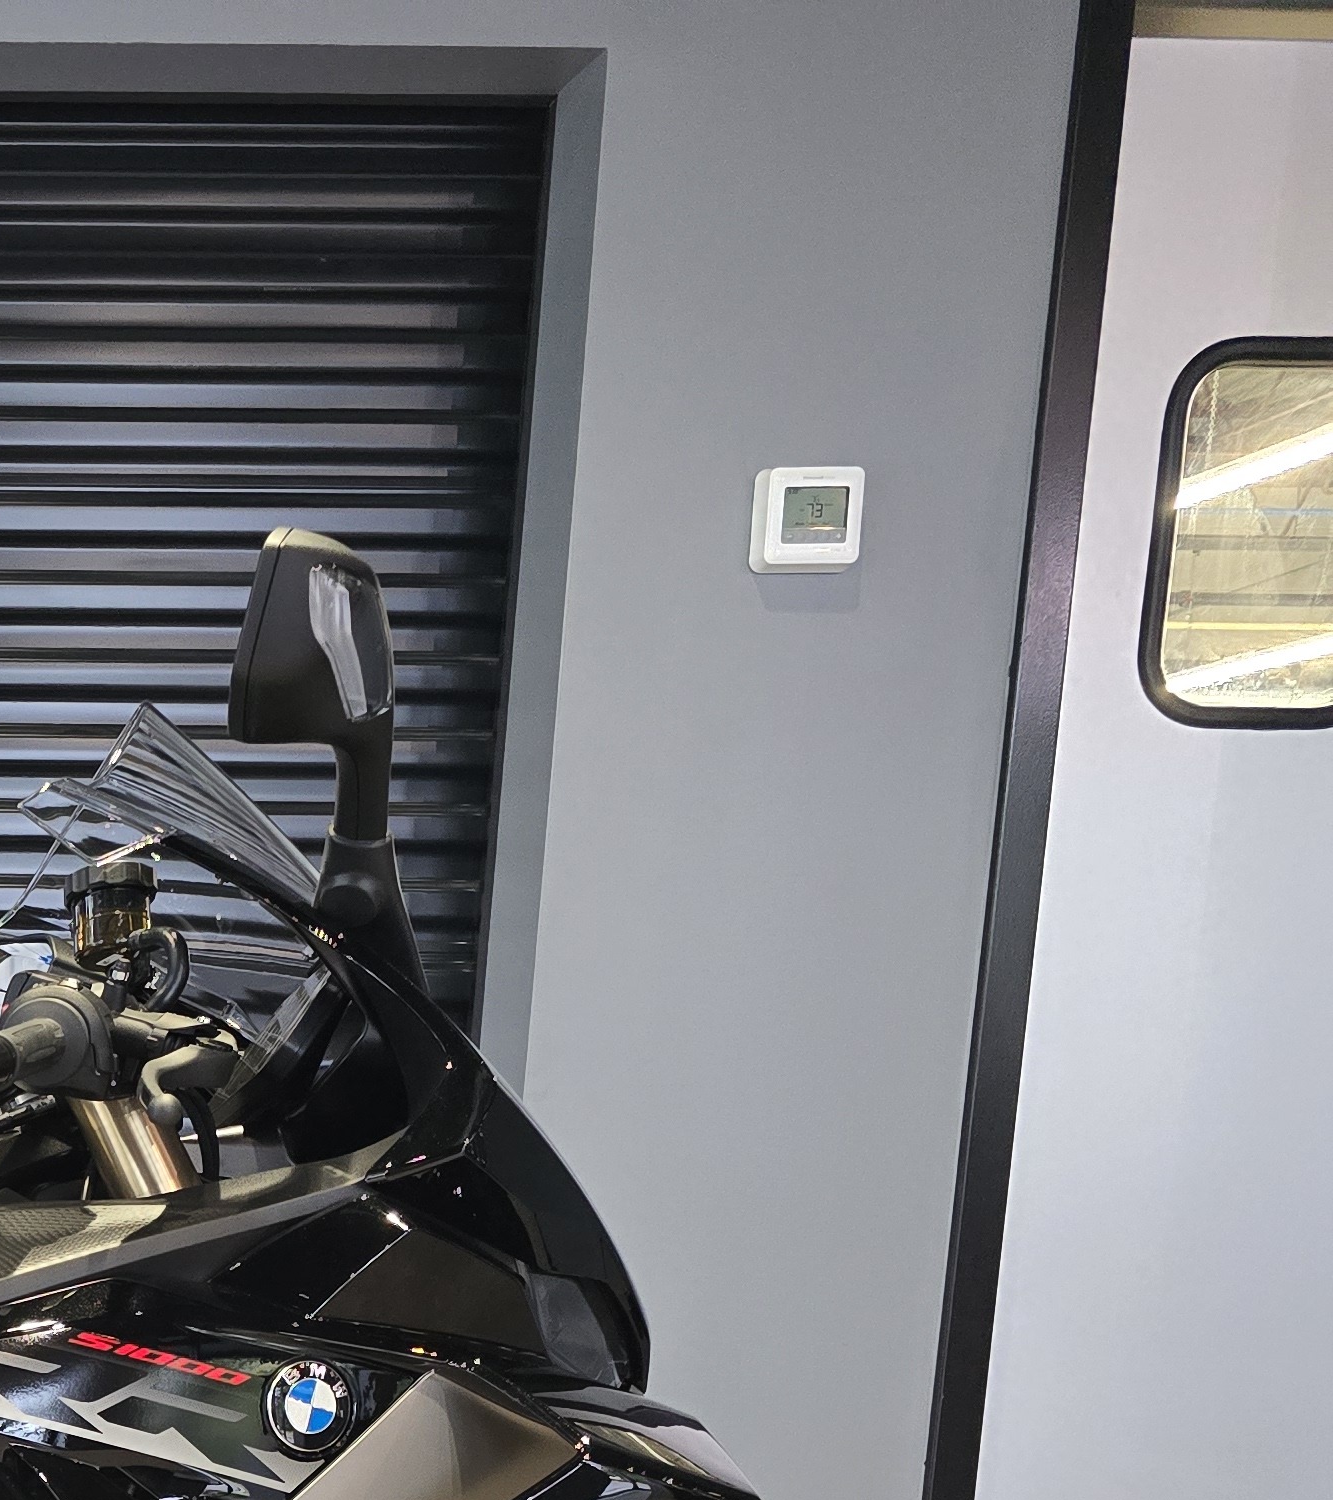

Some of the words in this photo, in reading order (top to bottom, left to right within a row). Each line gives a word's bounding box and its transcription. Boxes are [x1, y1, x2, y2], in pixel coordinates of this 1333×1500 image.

[806, 503, 824, 519] 73
[68, 1331, 252, 1387] S1000
[282, 1361, 349, 1399] BMW
